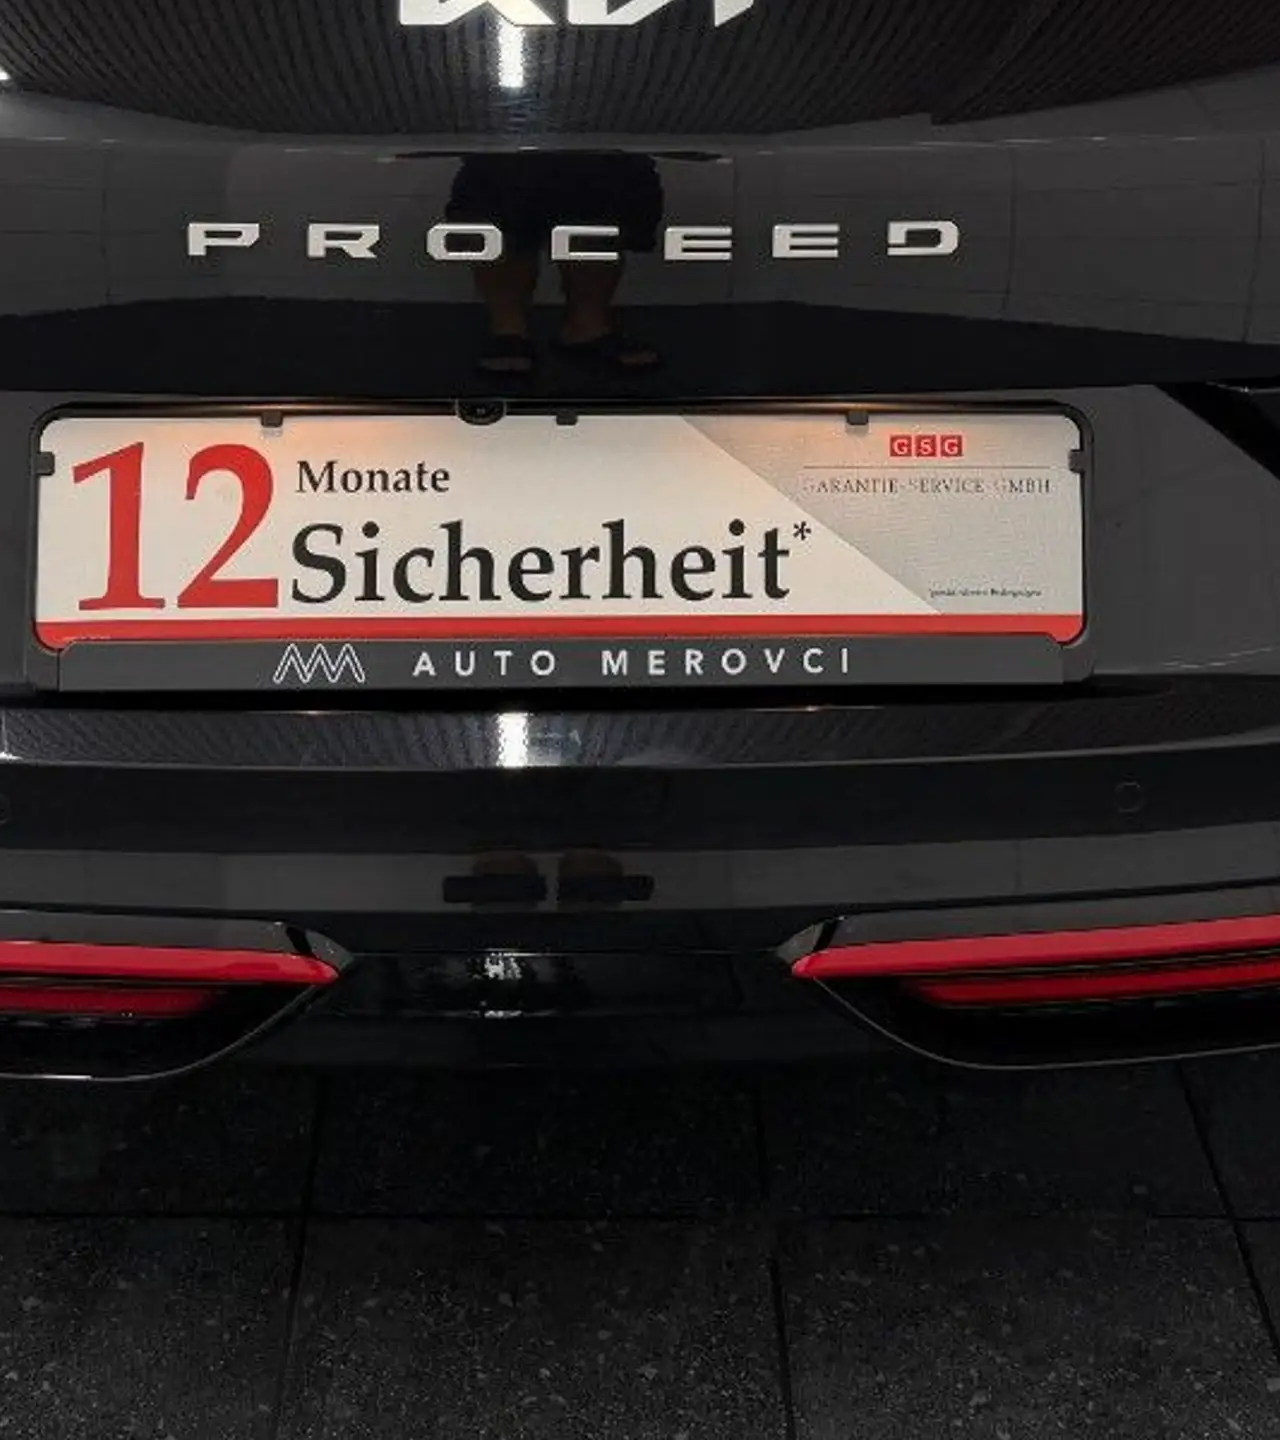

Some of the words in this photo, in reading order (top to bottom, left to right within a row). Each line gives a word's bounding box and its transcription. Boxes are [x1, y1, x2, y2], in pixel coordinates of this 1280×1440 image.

[186, 220, 961, 262] PROCEED
[891, 437, 961, 456] GSG
[296, 460, 450, 494] Monate
[73, 441, 279, 610] 12
[413, 650, 557, 677] AUTO
[601, 647, 851, 676] MEROVCI
